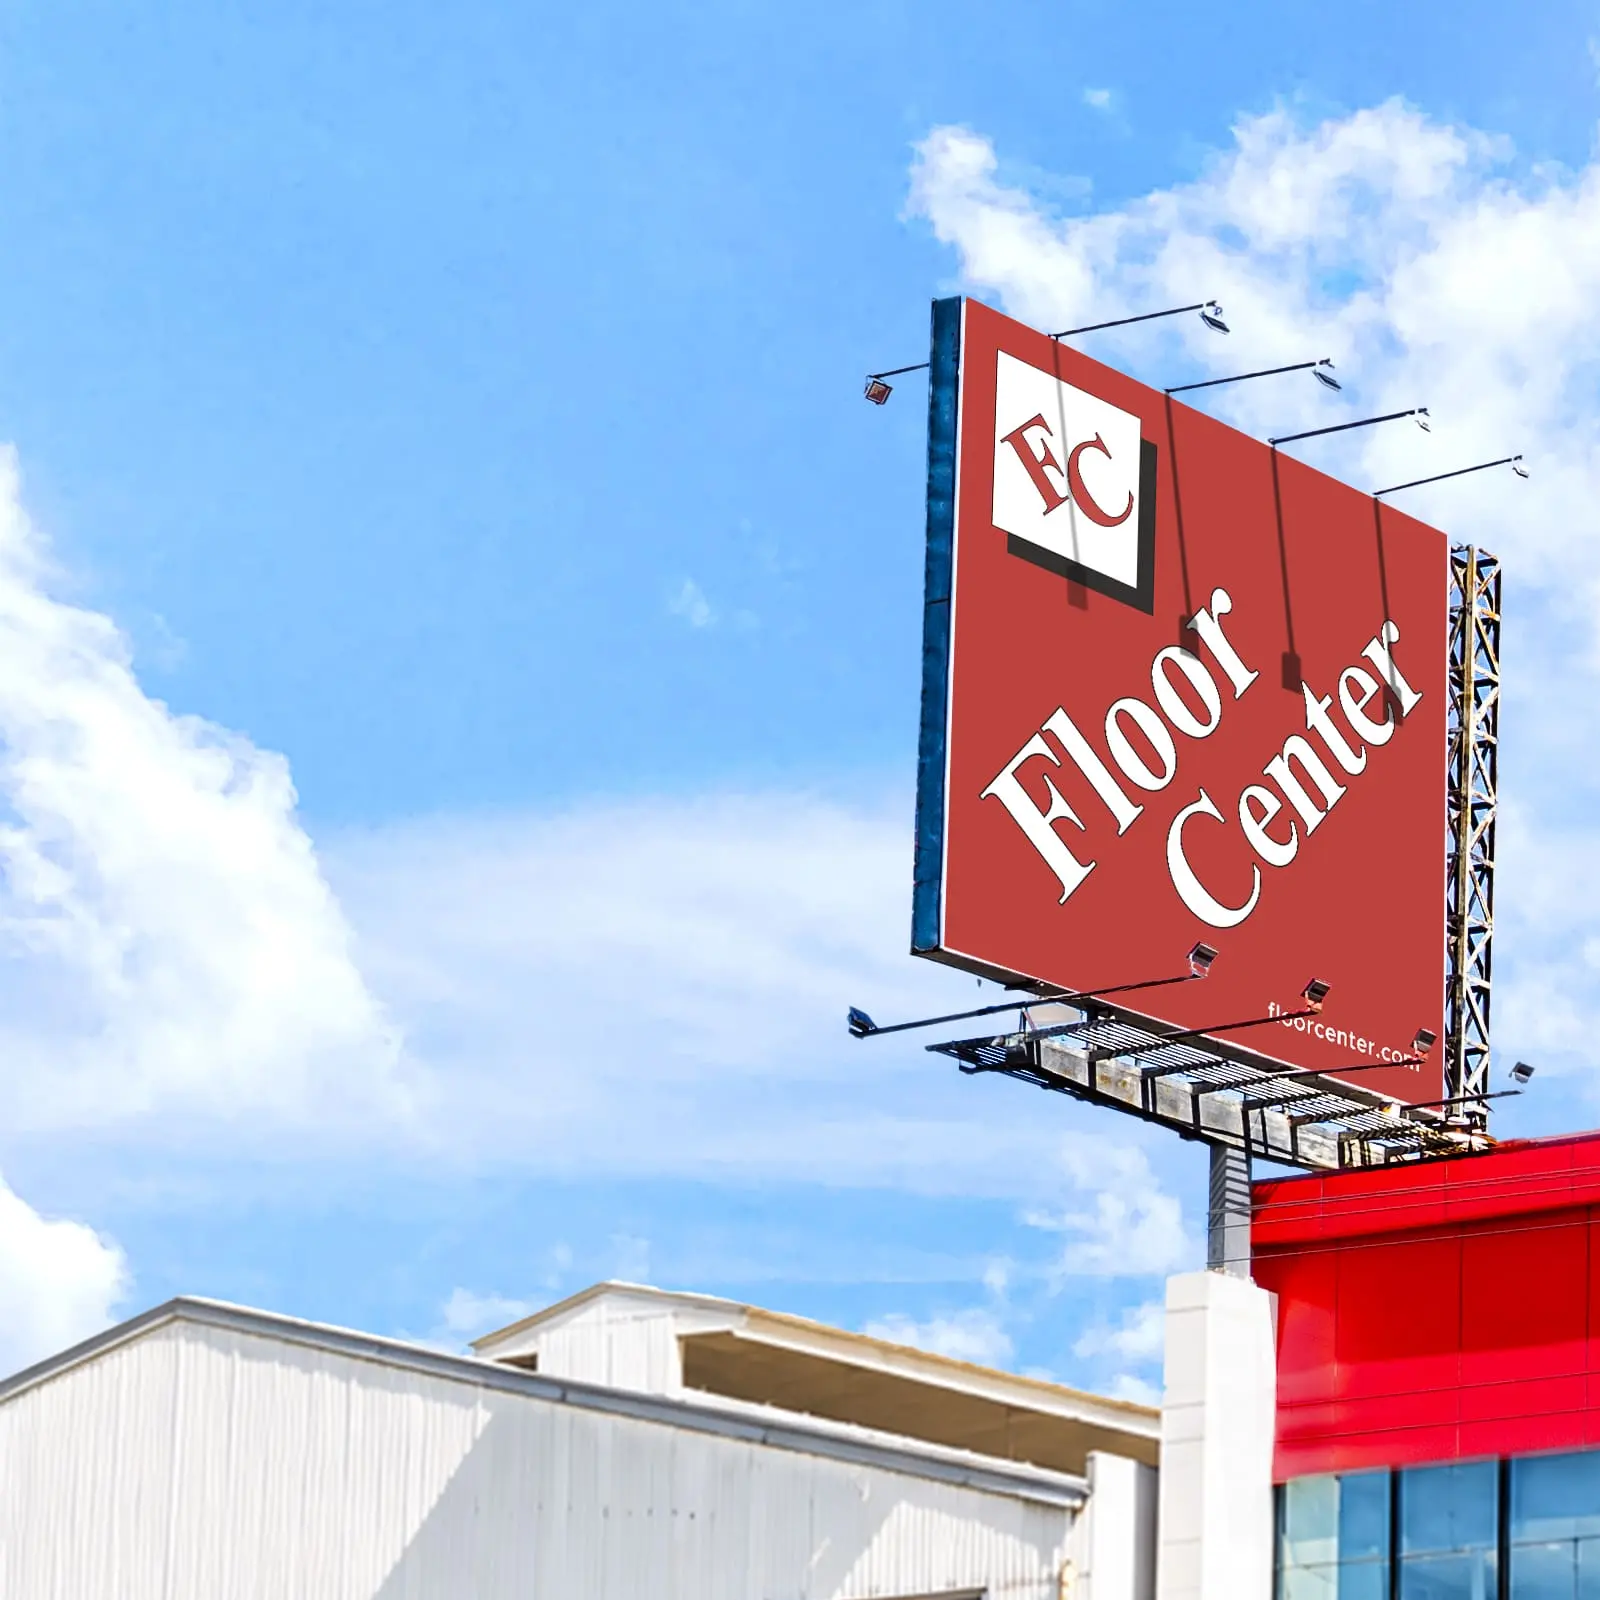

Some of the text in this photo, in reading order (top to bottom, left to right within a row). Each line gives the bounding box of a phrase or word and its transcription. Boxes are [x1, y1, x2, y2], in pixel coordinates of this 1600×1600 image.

[1000, 412, 1135, 528] FC
[979, 586, 1259, 906] Floor
[1165, 619, 1424, 929] Center
